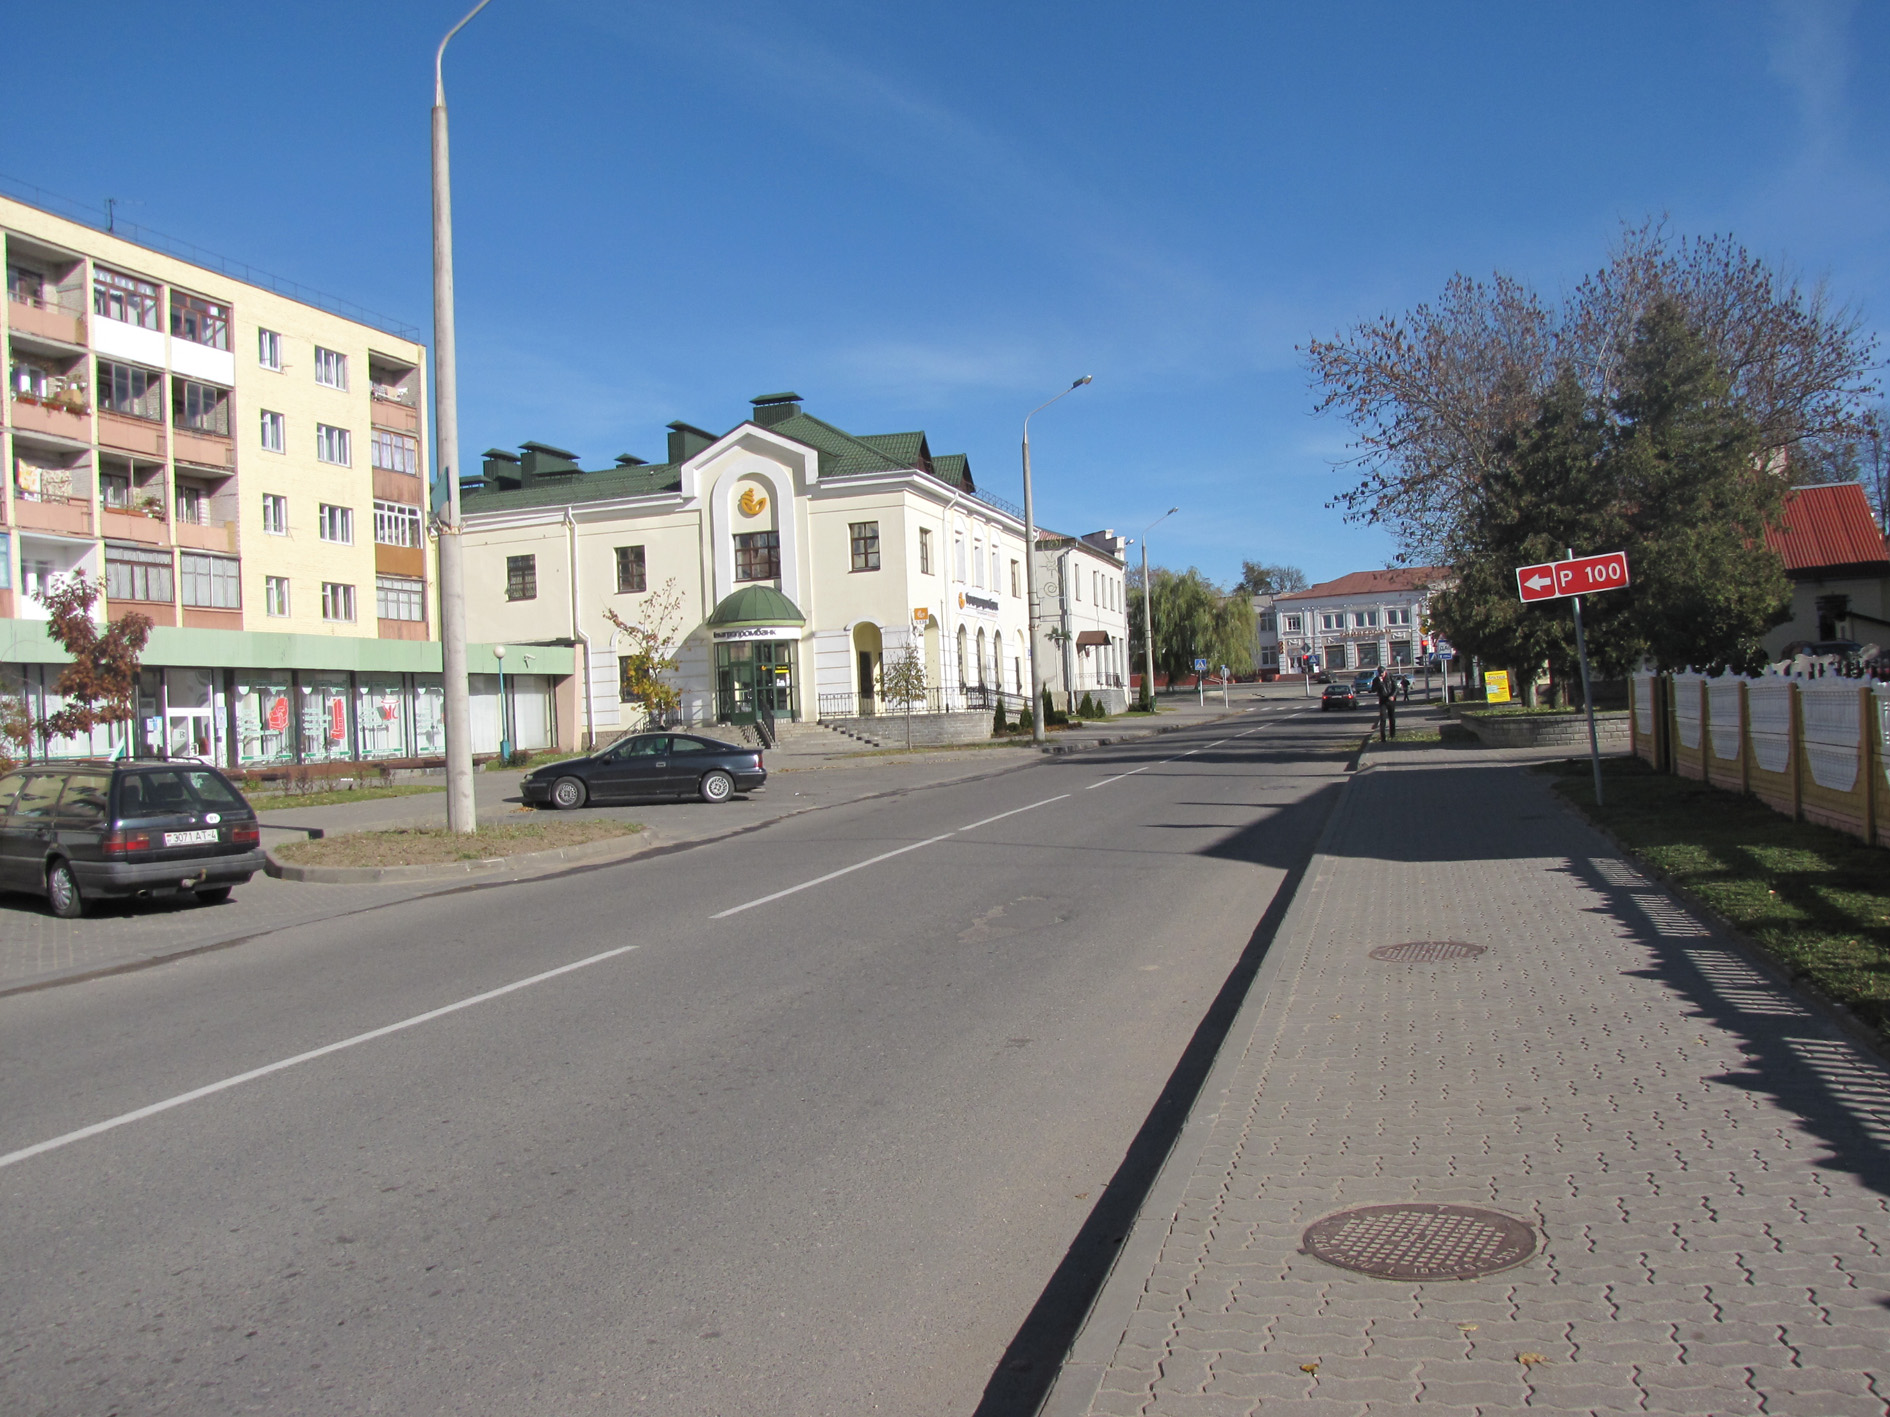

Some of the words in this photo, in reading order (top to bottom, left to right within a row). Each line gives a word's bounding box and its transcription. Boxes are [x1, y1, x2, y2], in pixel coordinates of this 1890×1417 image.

[1560, 570, 1573, 587] P
[1585, 562, 1620, 583] 100
[173, 833, 193, 842] 3071
